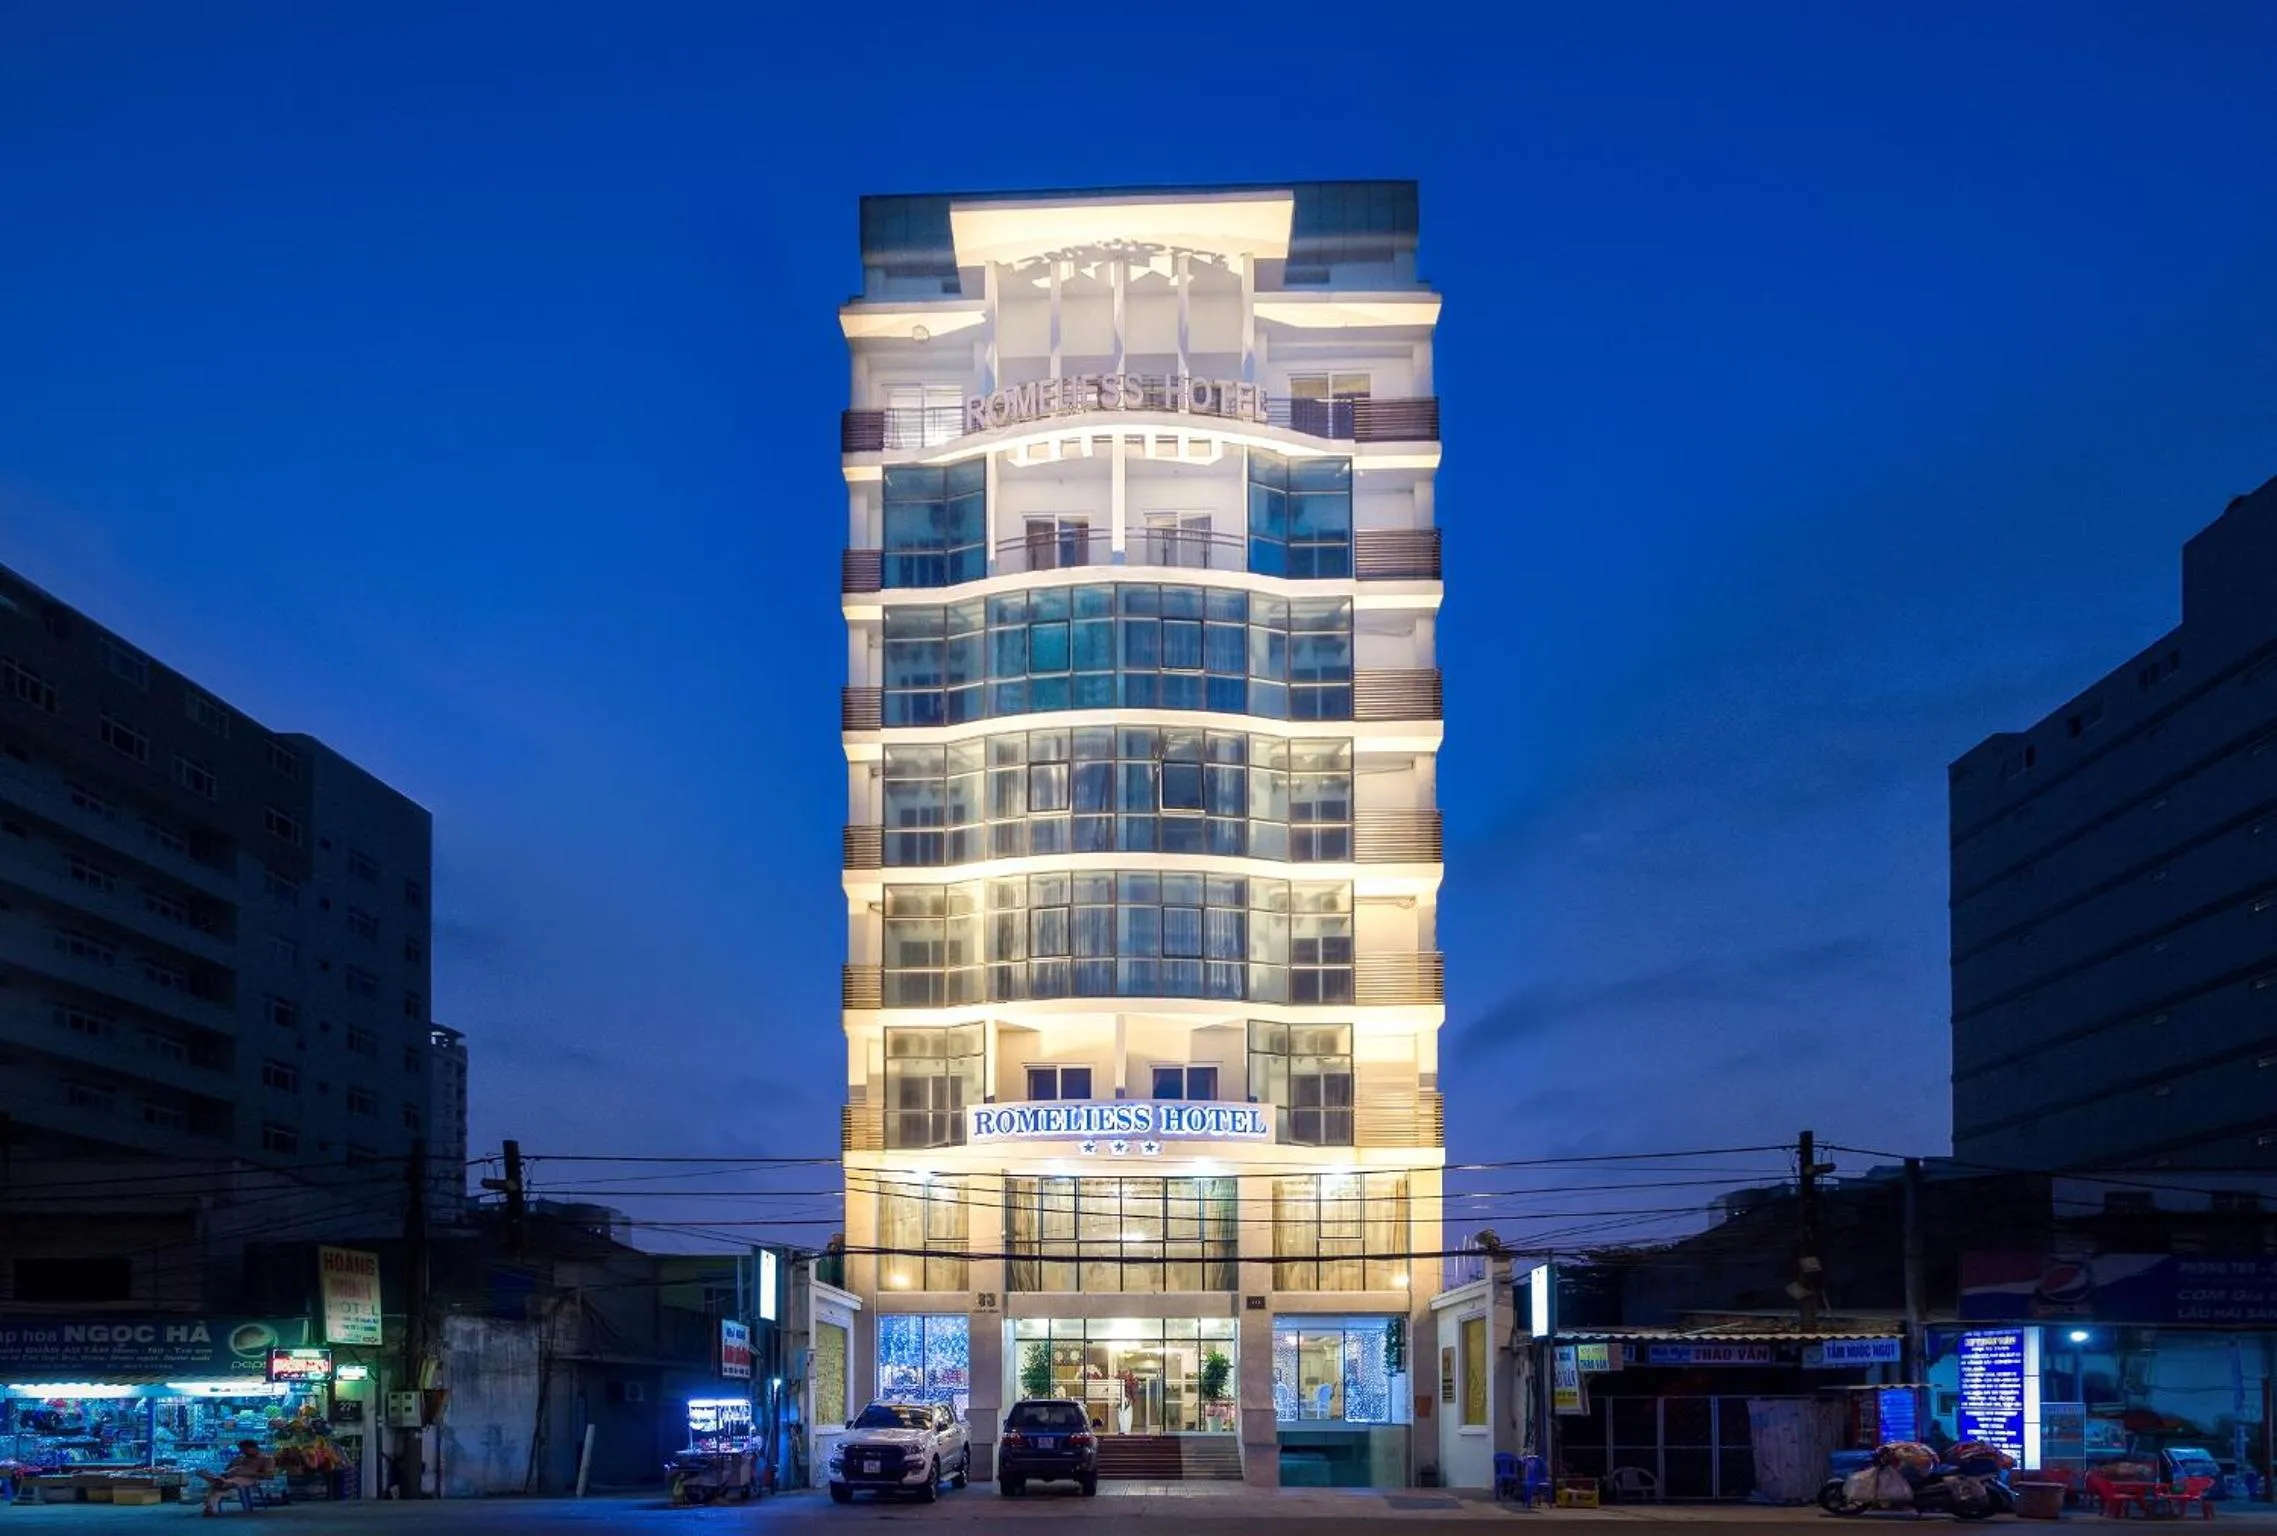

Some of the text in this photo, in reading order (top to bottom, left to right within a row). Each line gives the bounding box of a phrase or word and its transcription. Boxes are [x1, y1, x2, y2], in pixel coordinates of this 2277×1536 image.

[963, 373, 1269, 434] ROMELIESS HOTEL
[974, 1104, 1268, 1136] ROMELIESS HOTEL
[64, 1324, 157, 1348] NGỌC
